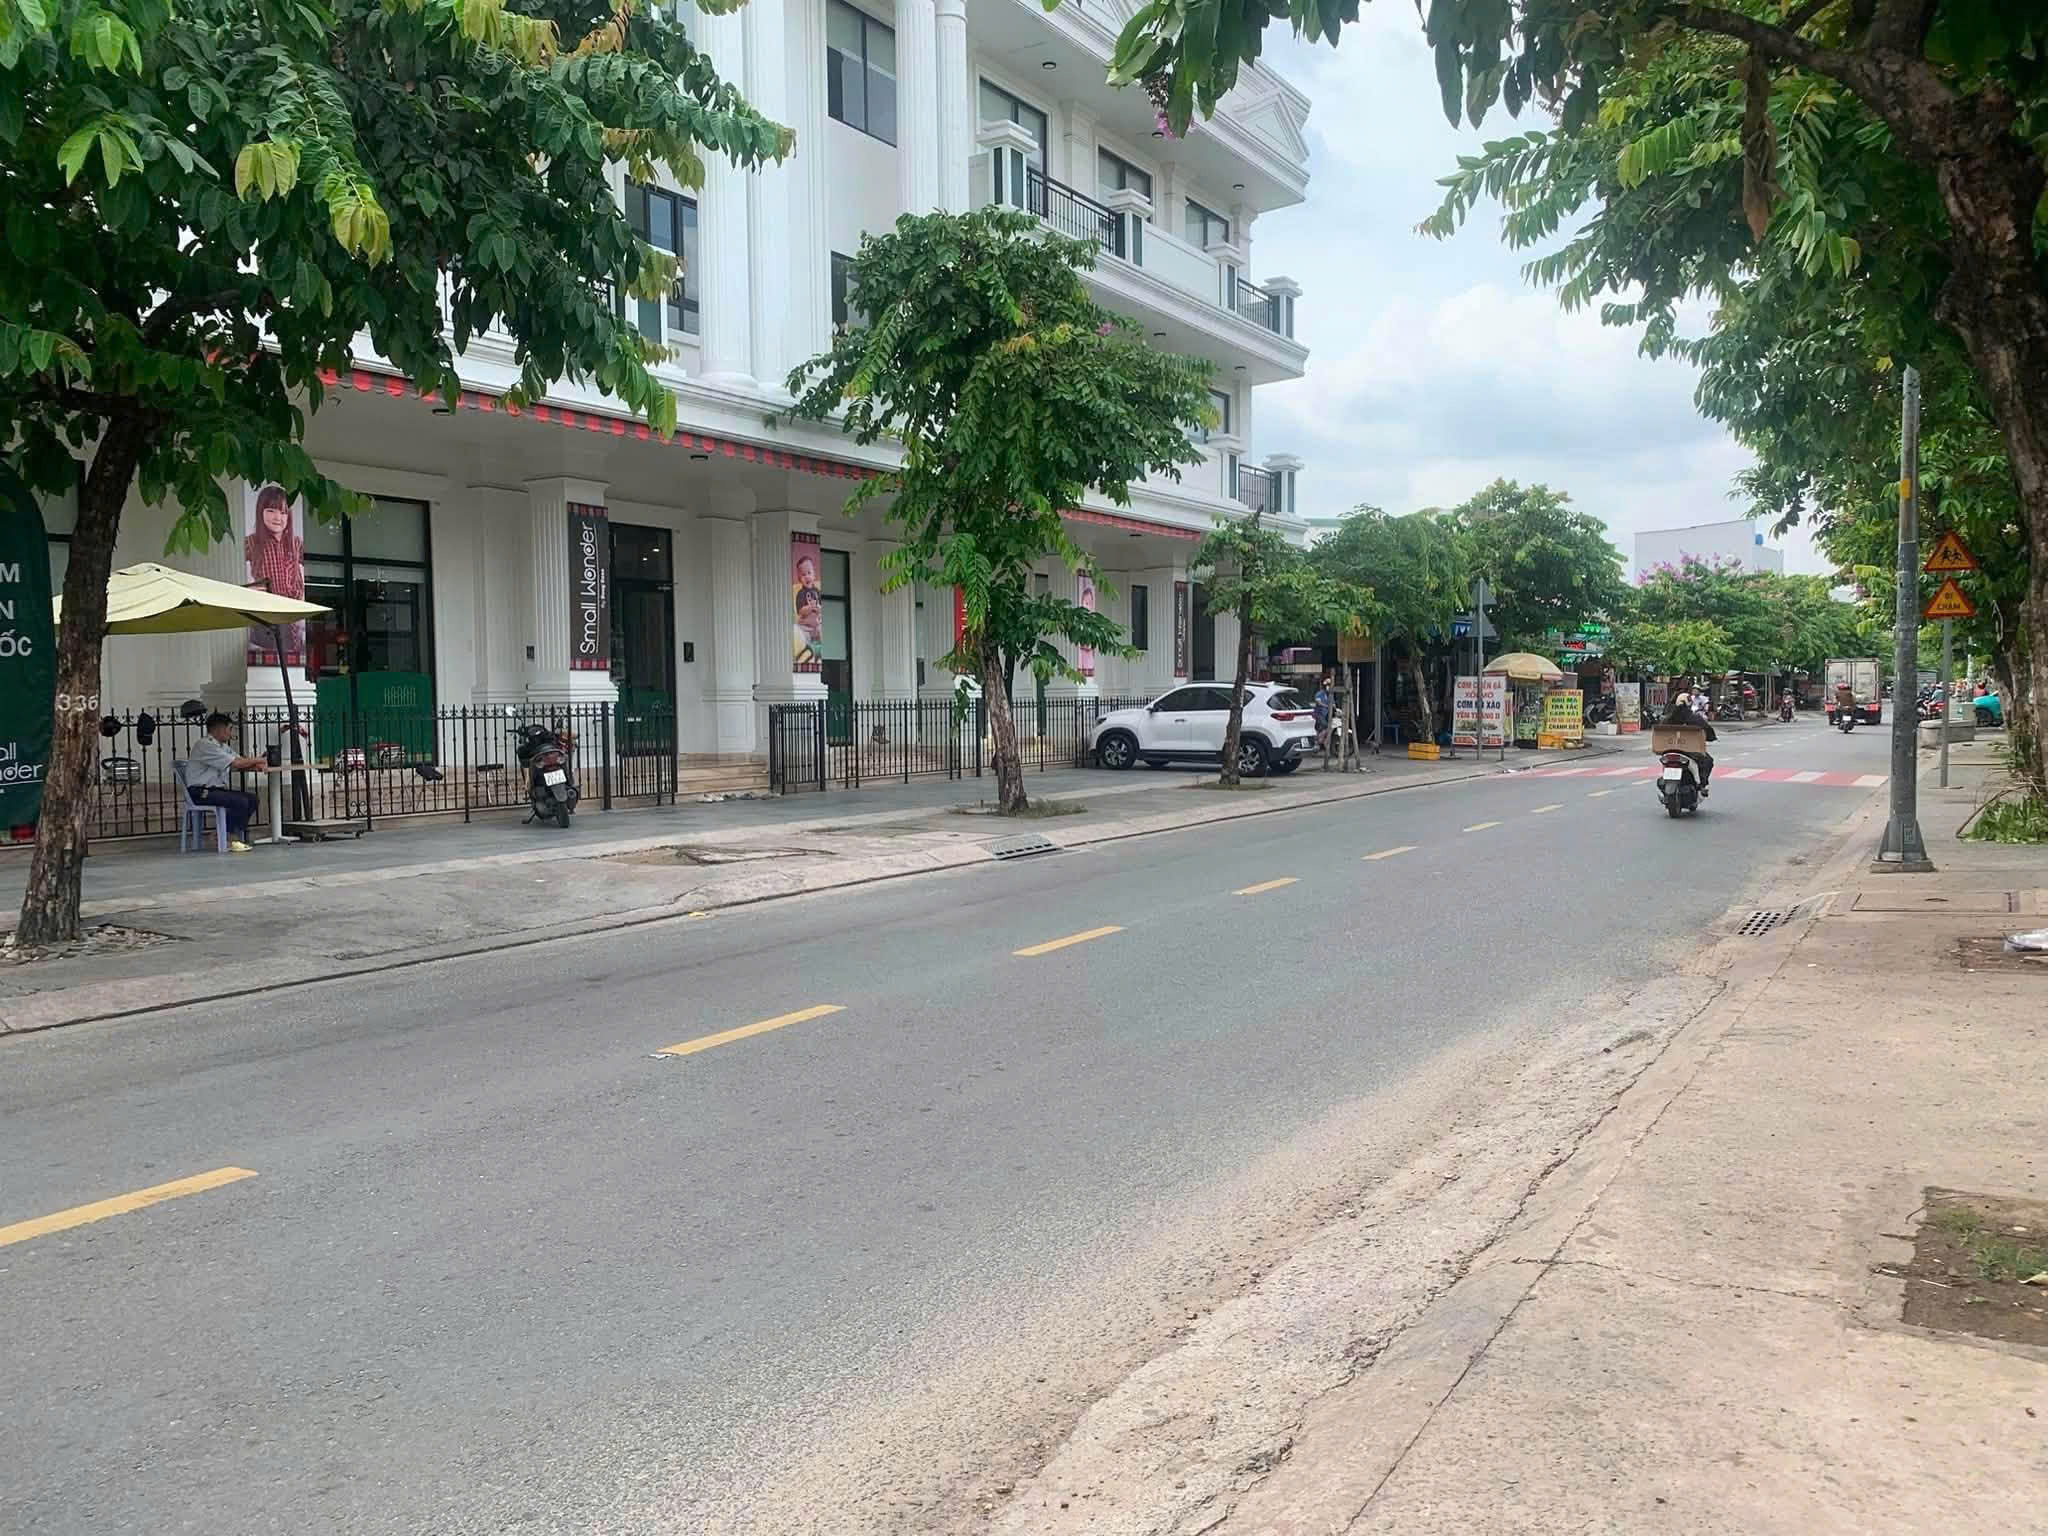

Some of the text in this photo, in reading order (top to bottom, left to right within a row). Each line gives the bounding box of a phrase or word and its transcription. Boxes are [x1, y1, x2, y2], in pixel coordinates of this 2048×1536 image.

[579, 521, 598, 654] Small Wonder
[0, 762, 43, 781] der
